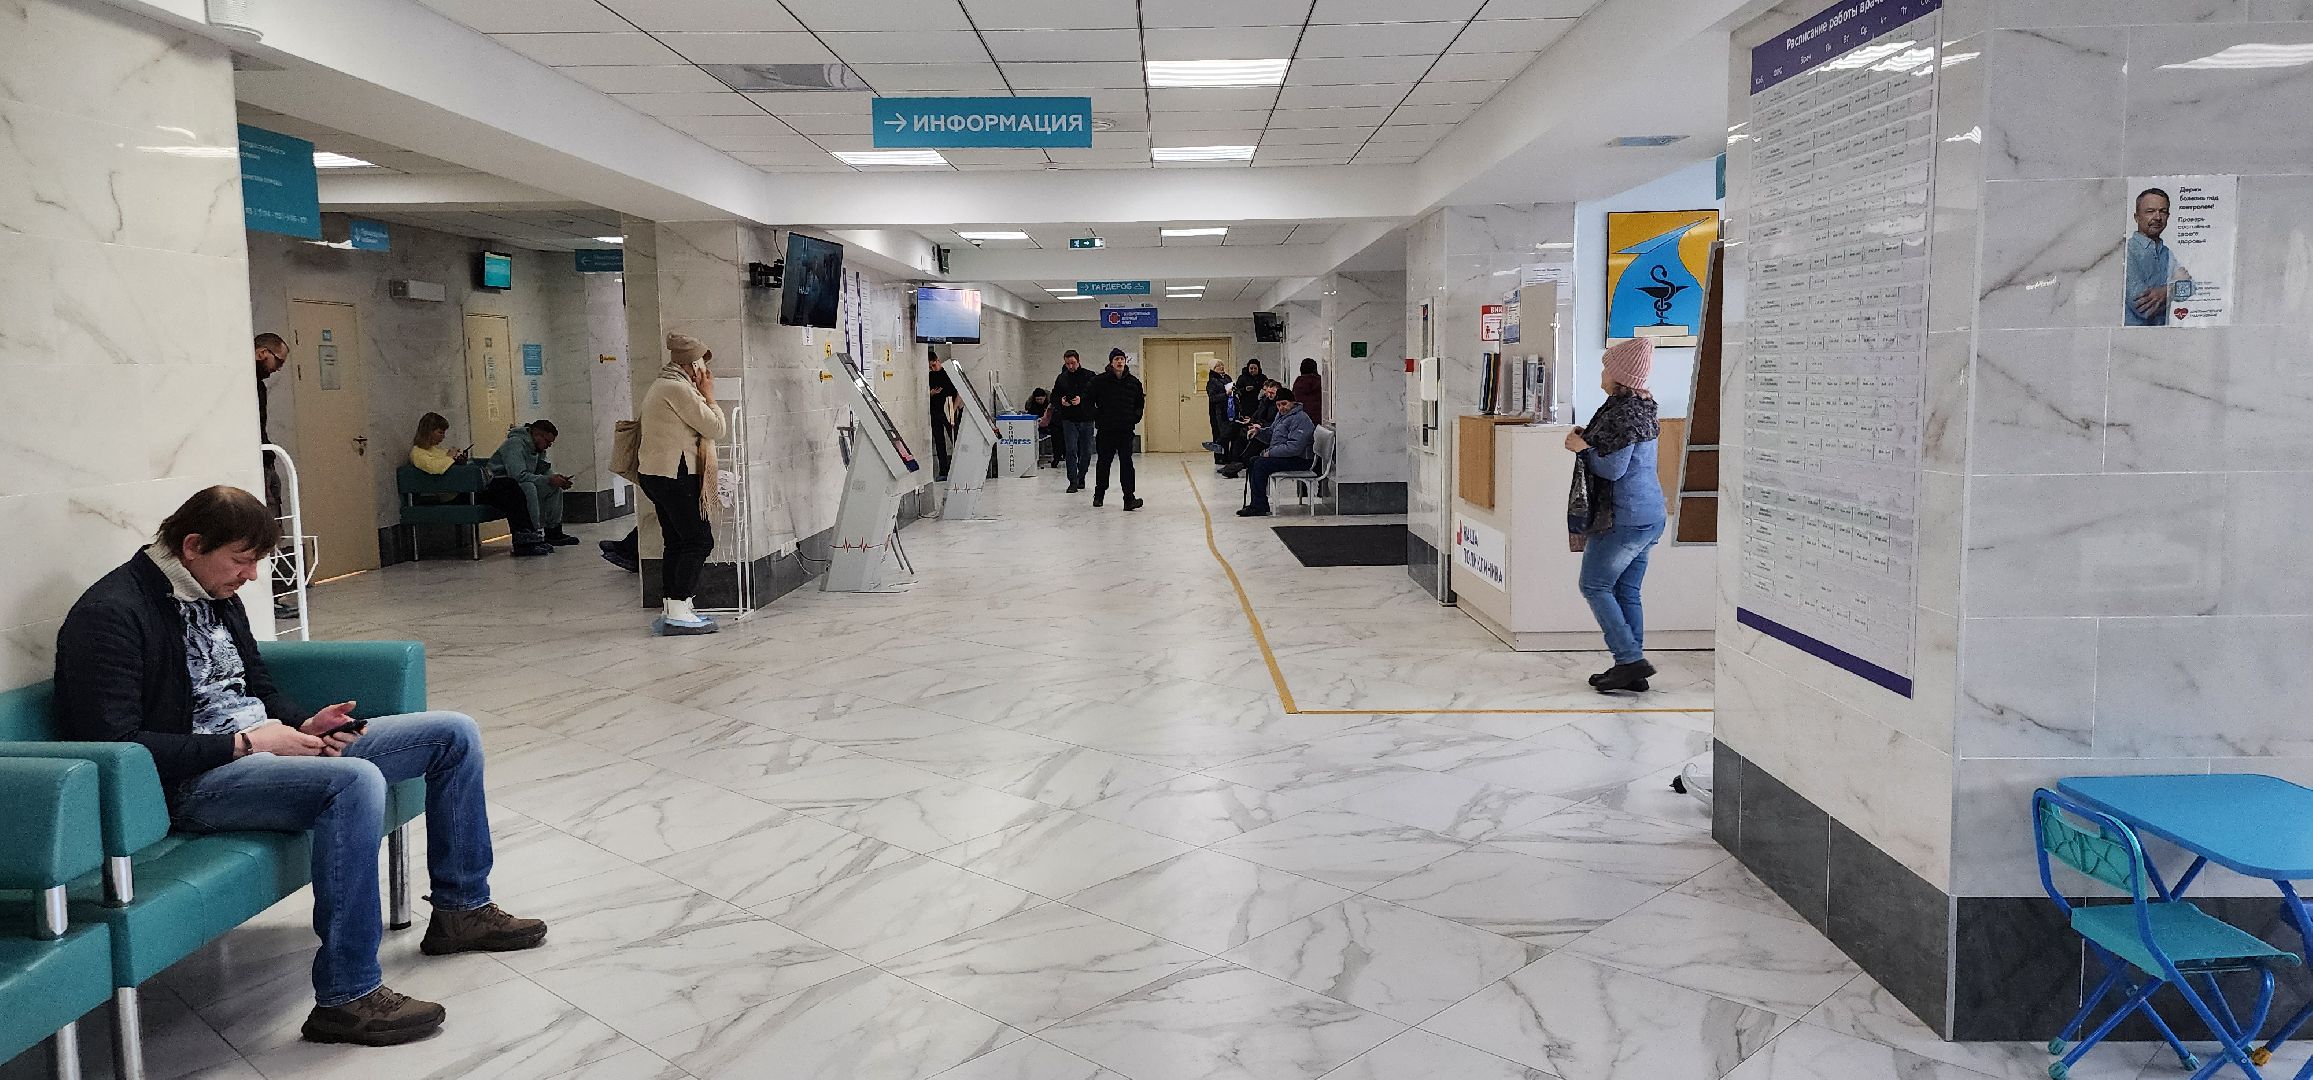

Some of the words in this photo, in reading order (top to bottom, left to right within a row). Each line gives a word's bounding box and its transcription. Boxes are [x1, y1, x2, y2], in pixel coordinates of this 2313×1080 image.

[1786, 21, 1828, 50] Расписание
[1829, 5, 1858, 31] работы
[912, 113, 1084, 135] ИНФОРМАЦИЯ
[1092, 282, 1132, 291] ГАРДЕРОБ
[1463, 547, 1503, 583] ПОЛИКЛИНИКА
